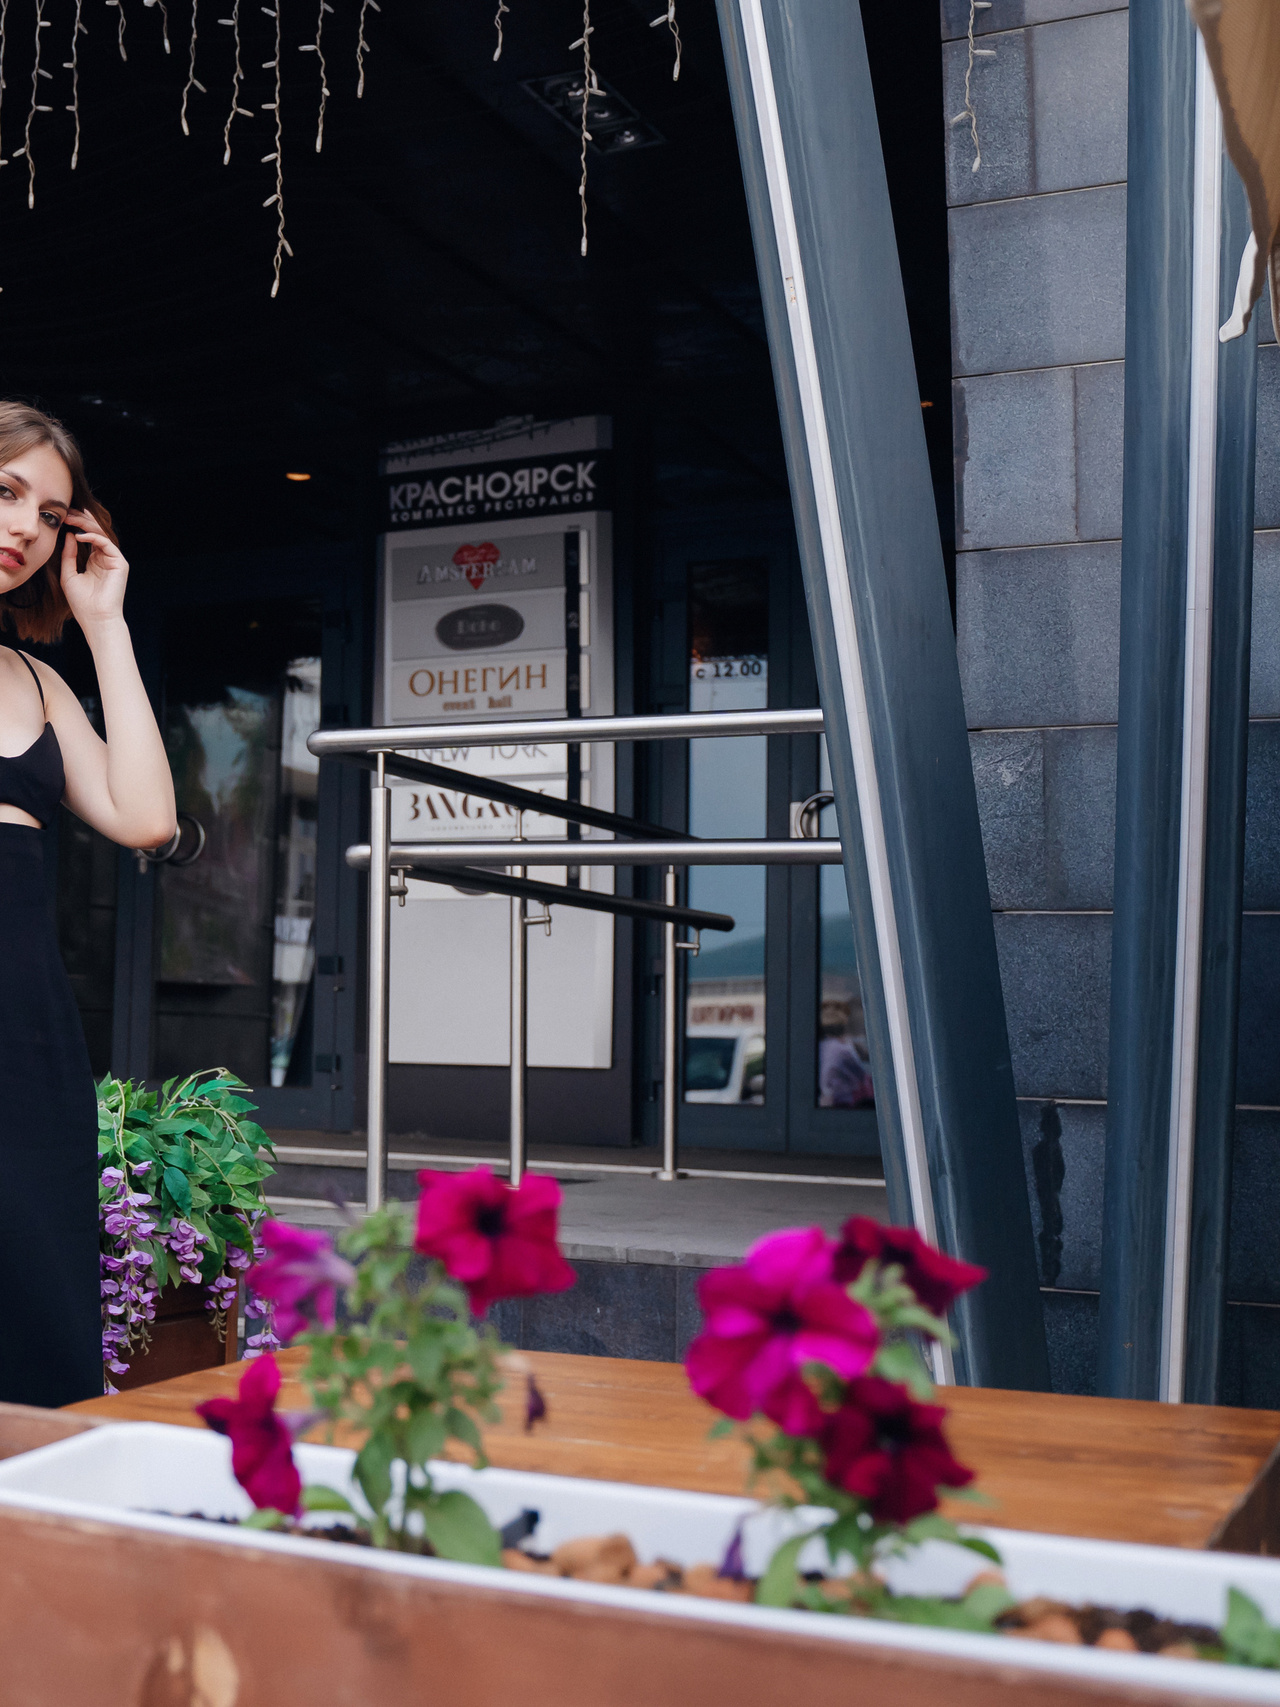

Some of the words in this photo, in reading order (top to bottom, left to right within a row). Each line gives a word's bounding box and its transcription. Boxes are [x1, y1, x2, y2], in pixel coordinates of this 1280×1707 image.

[389, 460, 598, 510] КРАСНОЯРСК
[391, 503, 476, 523] КОМПЛЕКС
[484, 492, 595, 512] РЕСТОРАНОВ
[408, 664, 548, 697] ОНЕГИН
[714, 660, 762, 678] 12.00
[410, 788, 546, 821] BANG
